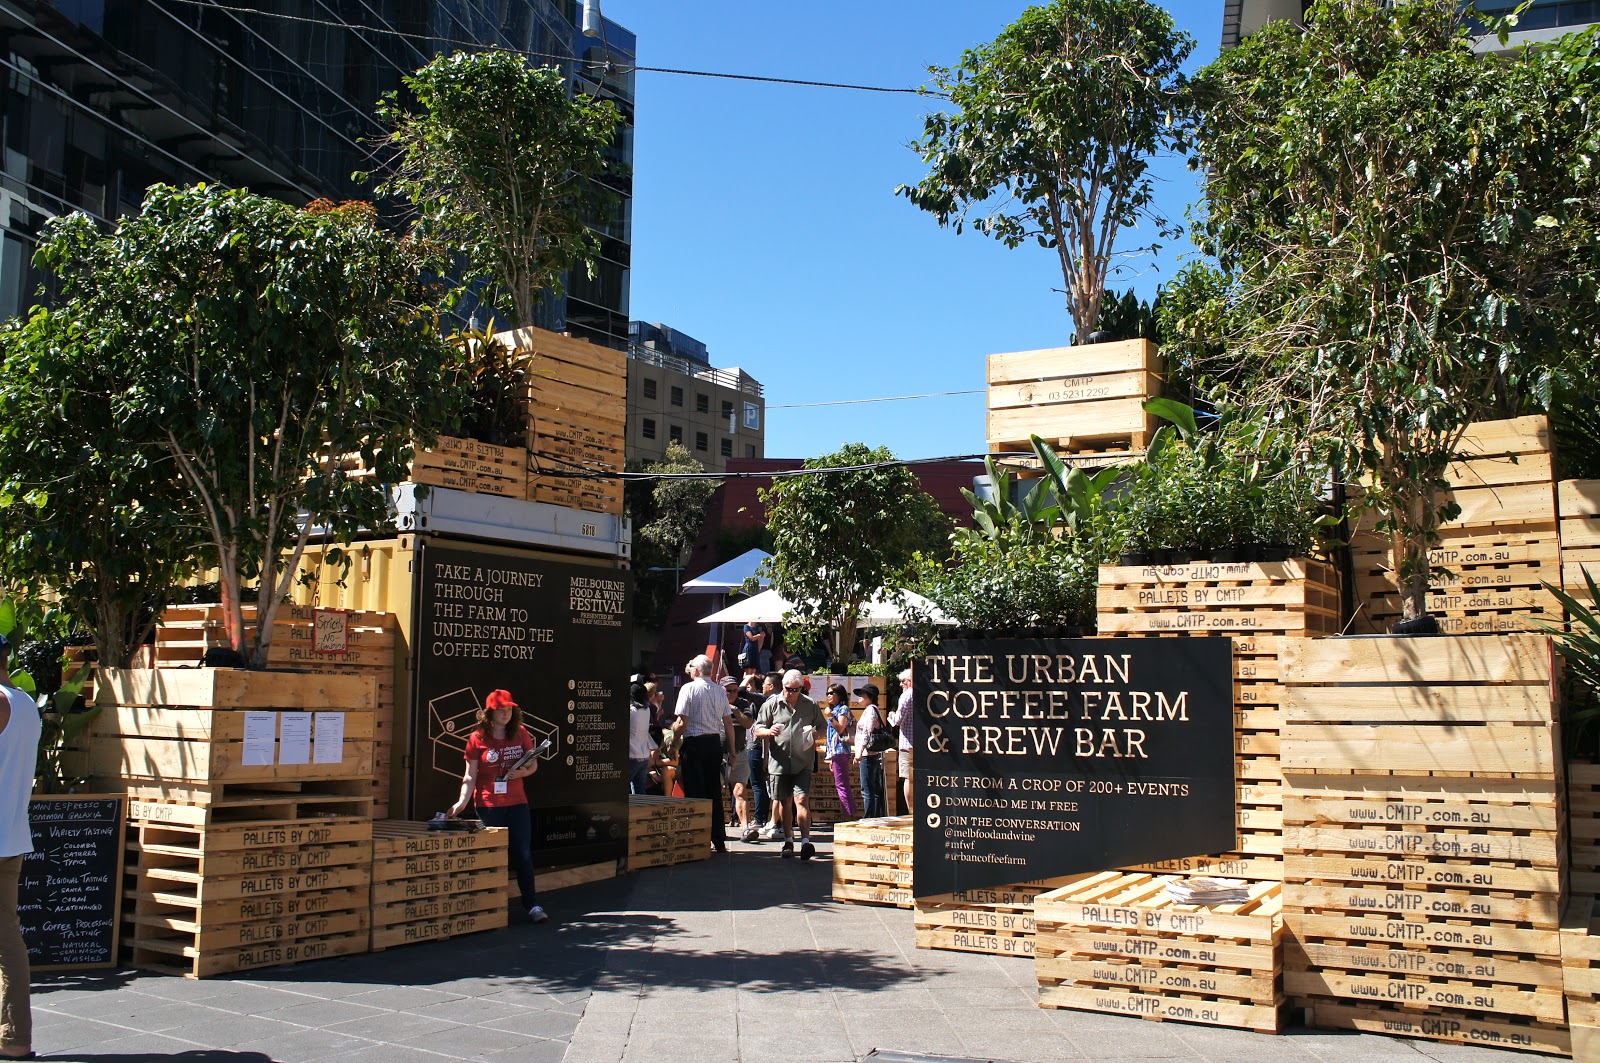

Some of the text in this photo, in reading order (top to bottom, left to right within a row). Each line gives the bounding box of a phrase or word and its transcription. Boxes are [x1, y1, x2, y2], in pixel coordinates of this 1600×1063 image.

[1064, 377, 1093, 388] CMTP
[1048, 392, 1060, 400] 03
[1062, 389, 1084, 399] 5231
[1087, 387, 1109, 397] 2292
[746, 403, 755, 424] P
[444, 458, 503, 475] www.CMTP.com.au
[581, 524, 596, 537] 6818
[435, 563, 544, 588] TAKE A JOURNEY
[570, 576, 625, 592] MELBOURNE
[434, 583, 503, 603] THROUGH
[570, 587, 625, 601] FOOD & WINE
[1139, 588, 1246, 604] PALLETS BY CMTP
[434, 602, 528, 623] THE FARM TO
[569, 597, 625, 614] FESTIVAL
[572, 617, 586, 625] BANK
[593, 618, 622, 627] MELBOURNE
[580, 612, 604, 620] PRESENTED
[433, 622, 554, 643] UNDERSTAND THE
[433, 642, 536, 660] COFFEE STORY
[925, 654, 1131, 684] THE URBAN
[577, 681, 603, 689] COFFEE
[577, 689, 612, 697] VARIETALS
[577, 701, 604, 710] ORIGINS
[927, 690, 1189, 721] COFFEE FARM
[576, 722, 616, 731] PROCESSING
[577, 714, 602, 722] COFFEE
[576, 735, 602, 743] COFFEE
[576, 743, 610, 751] LOGISTICS
[927, 724, 1148, 759] & BREW BAR
[576, 756, 589, 764] THE
[576, 763, 614, 773] MELBOURNE
[576, 771, 621, 780] COFFEE STORY
[927, 775, 1189, 797] PICK FROM A CROP OF 200+ EVENTS
[55, 802, 99, 811] ESPRESSO
[155, 806, 173, 820] CMTP
[945, 797, 1078, 812] DOWNLOAD ME I'M FREE
[1349, 805, 1490, 823] www.CMTP.com.au
[50, 826, 82, 838] VARIETY
[647, 822, 669, 832] PALLETS
[670, 822, 677, 830] BY
[944, 815, 1081, 832] JOIN THE CONVERSATION
[243, 828, 332, 846] PALLETS BY CMTP
[944, 828, 1036, 842] @melbfoodandwine
[405, 836, 476, 853] PALLETS BY CMTP
[944, 840, 976, 850] #mfwf
[1349, 834, 1490, 854] www.CMTP.com.au
[243, 850, 330, 870] PALLETS BY CMTP
[405, 856, 476, 874] PALLETS BY CMTP
[944, 851, 1026, 865] #urbancoffeefarm
[1197, 860, 1249, 875] BY CMTP
[1351, 865, 1493, 885] www.CMTP.com.au
[241, 874, 329, 894] PALLETS BY CMTP
[406, 878, 476, 896] PALLETS BY CMTP
[1003, 892, 1017, 905] BY
[1349, 894, 1491, 915] www.CMTP.com.au
[240, 897, 328, 918] PALLETS BY CMTP
[405, 898, 475, 919] PALLETS BY CMTP
[952, 911, 1017, 928] PALLETS BY
[1082, 906, 1204, 931] PALLETS BY CMTP
[240, 919, 328, 943] PALLETS BY CMTP
[405, 919, 476, 940] PALLETS BY CMTP
[1350, 924, 1493, 946] www.CMTP.com.au
[953, 934, 1017, 951] PALLETS BY
[1093, 939, 1216, 962] www.CMTP.com.au
[238, 943, 327, 967] PALLETS BY CMTP
[1351, 953, 1495, 977] www.CMTP.com.au
[1093, 971, 1216, 991] www.CMTP.com.au
[1350, 983, 1494, 1008] www.CMTP.com.au
[1096, 997, 1219, 1022] www.CMTP.com.au
[1384, 1018, 1531, 1046] www.CMTP.com.au
